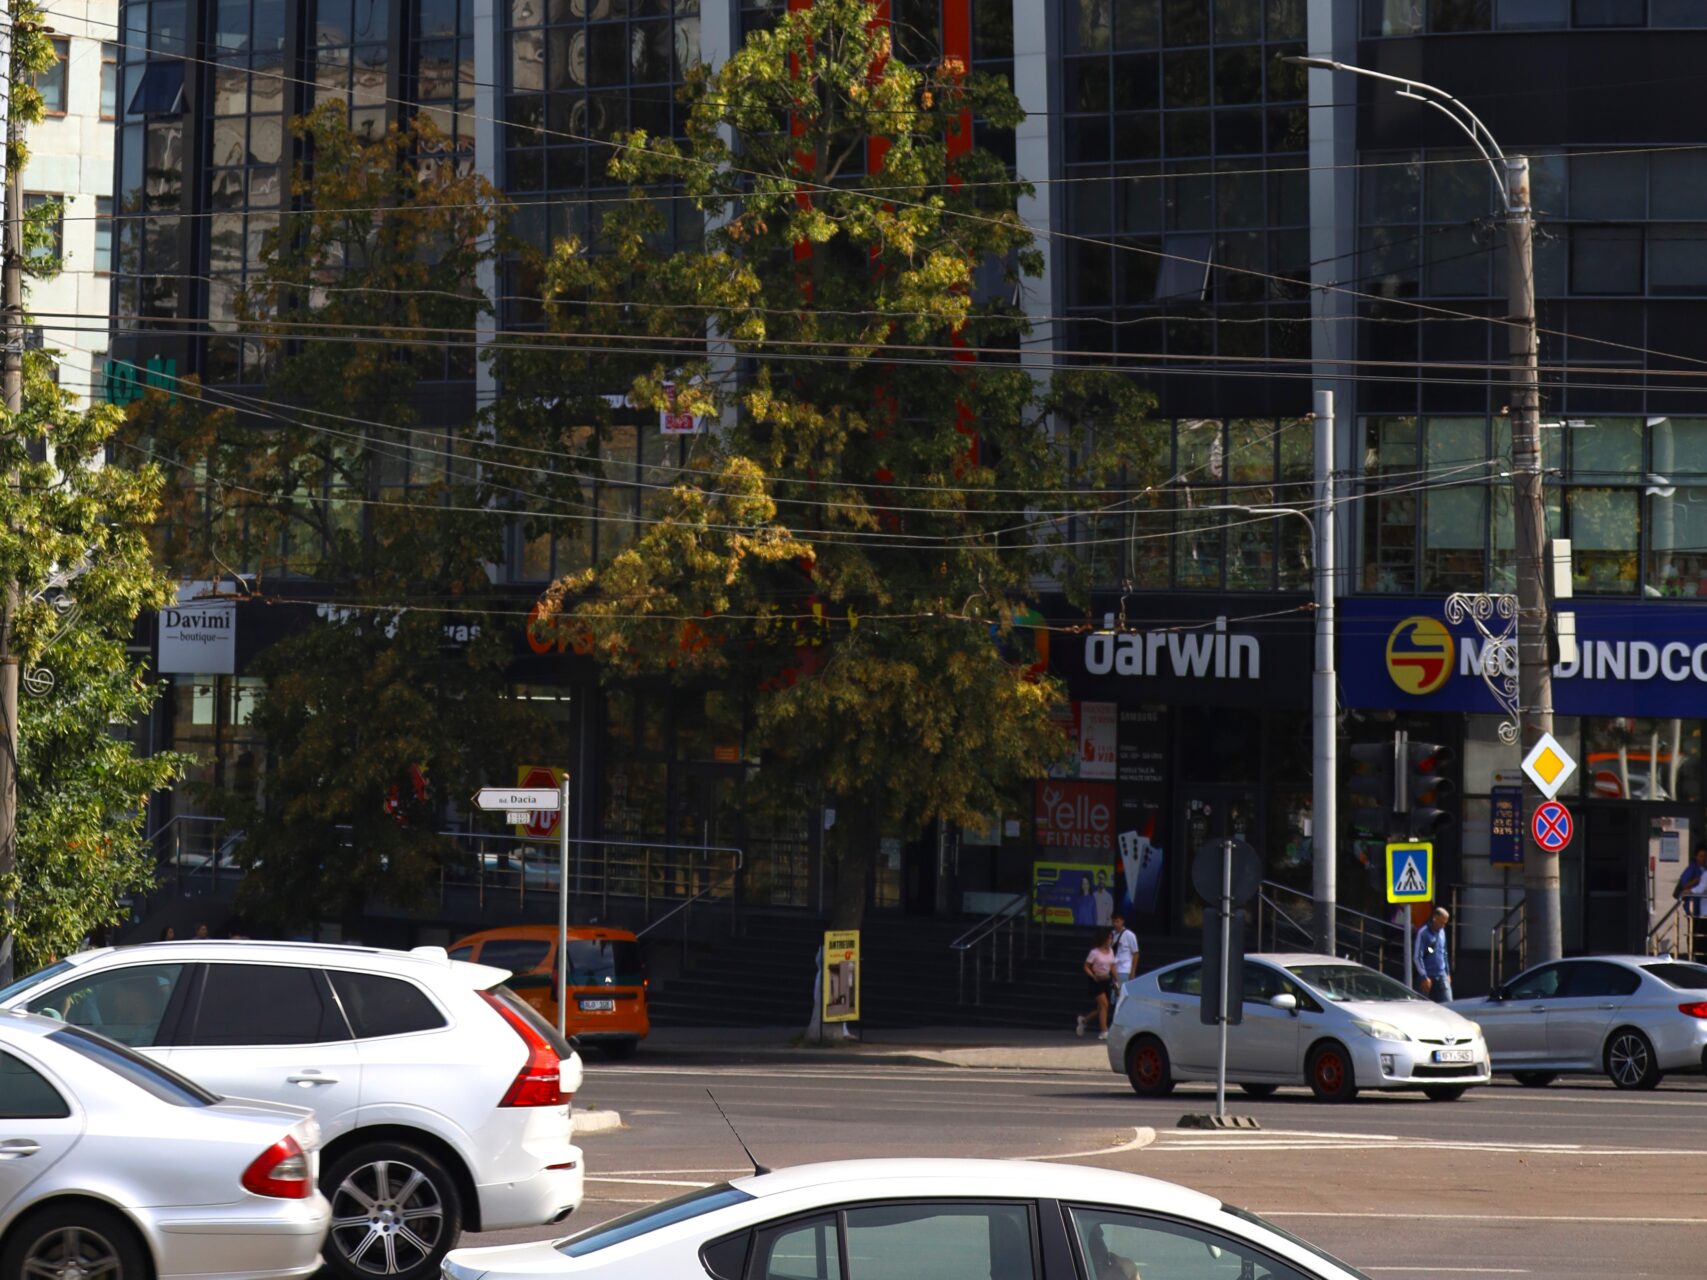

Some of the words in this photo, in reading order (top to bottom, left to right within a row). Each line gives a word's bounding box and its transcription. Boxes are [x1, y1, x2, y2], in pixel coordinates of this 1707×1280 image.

[165, 610, 230, 629] Davimi
[180, 631, 217, 645] boutique
[1085, 612, 1261, 679] darwin
[510, 795, 537, 804] Dacia
[1046, 832, 1111, 849] FITNESS
